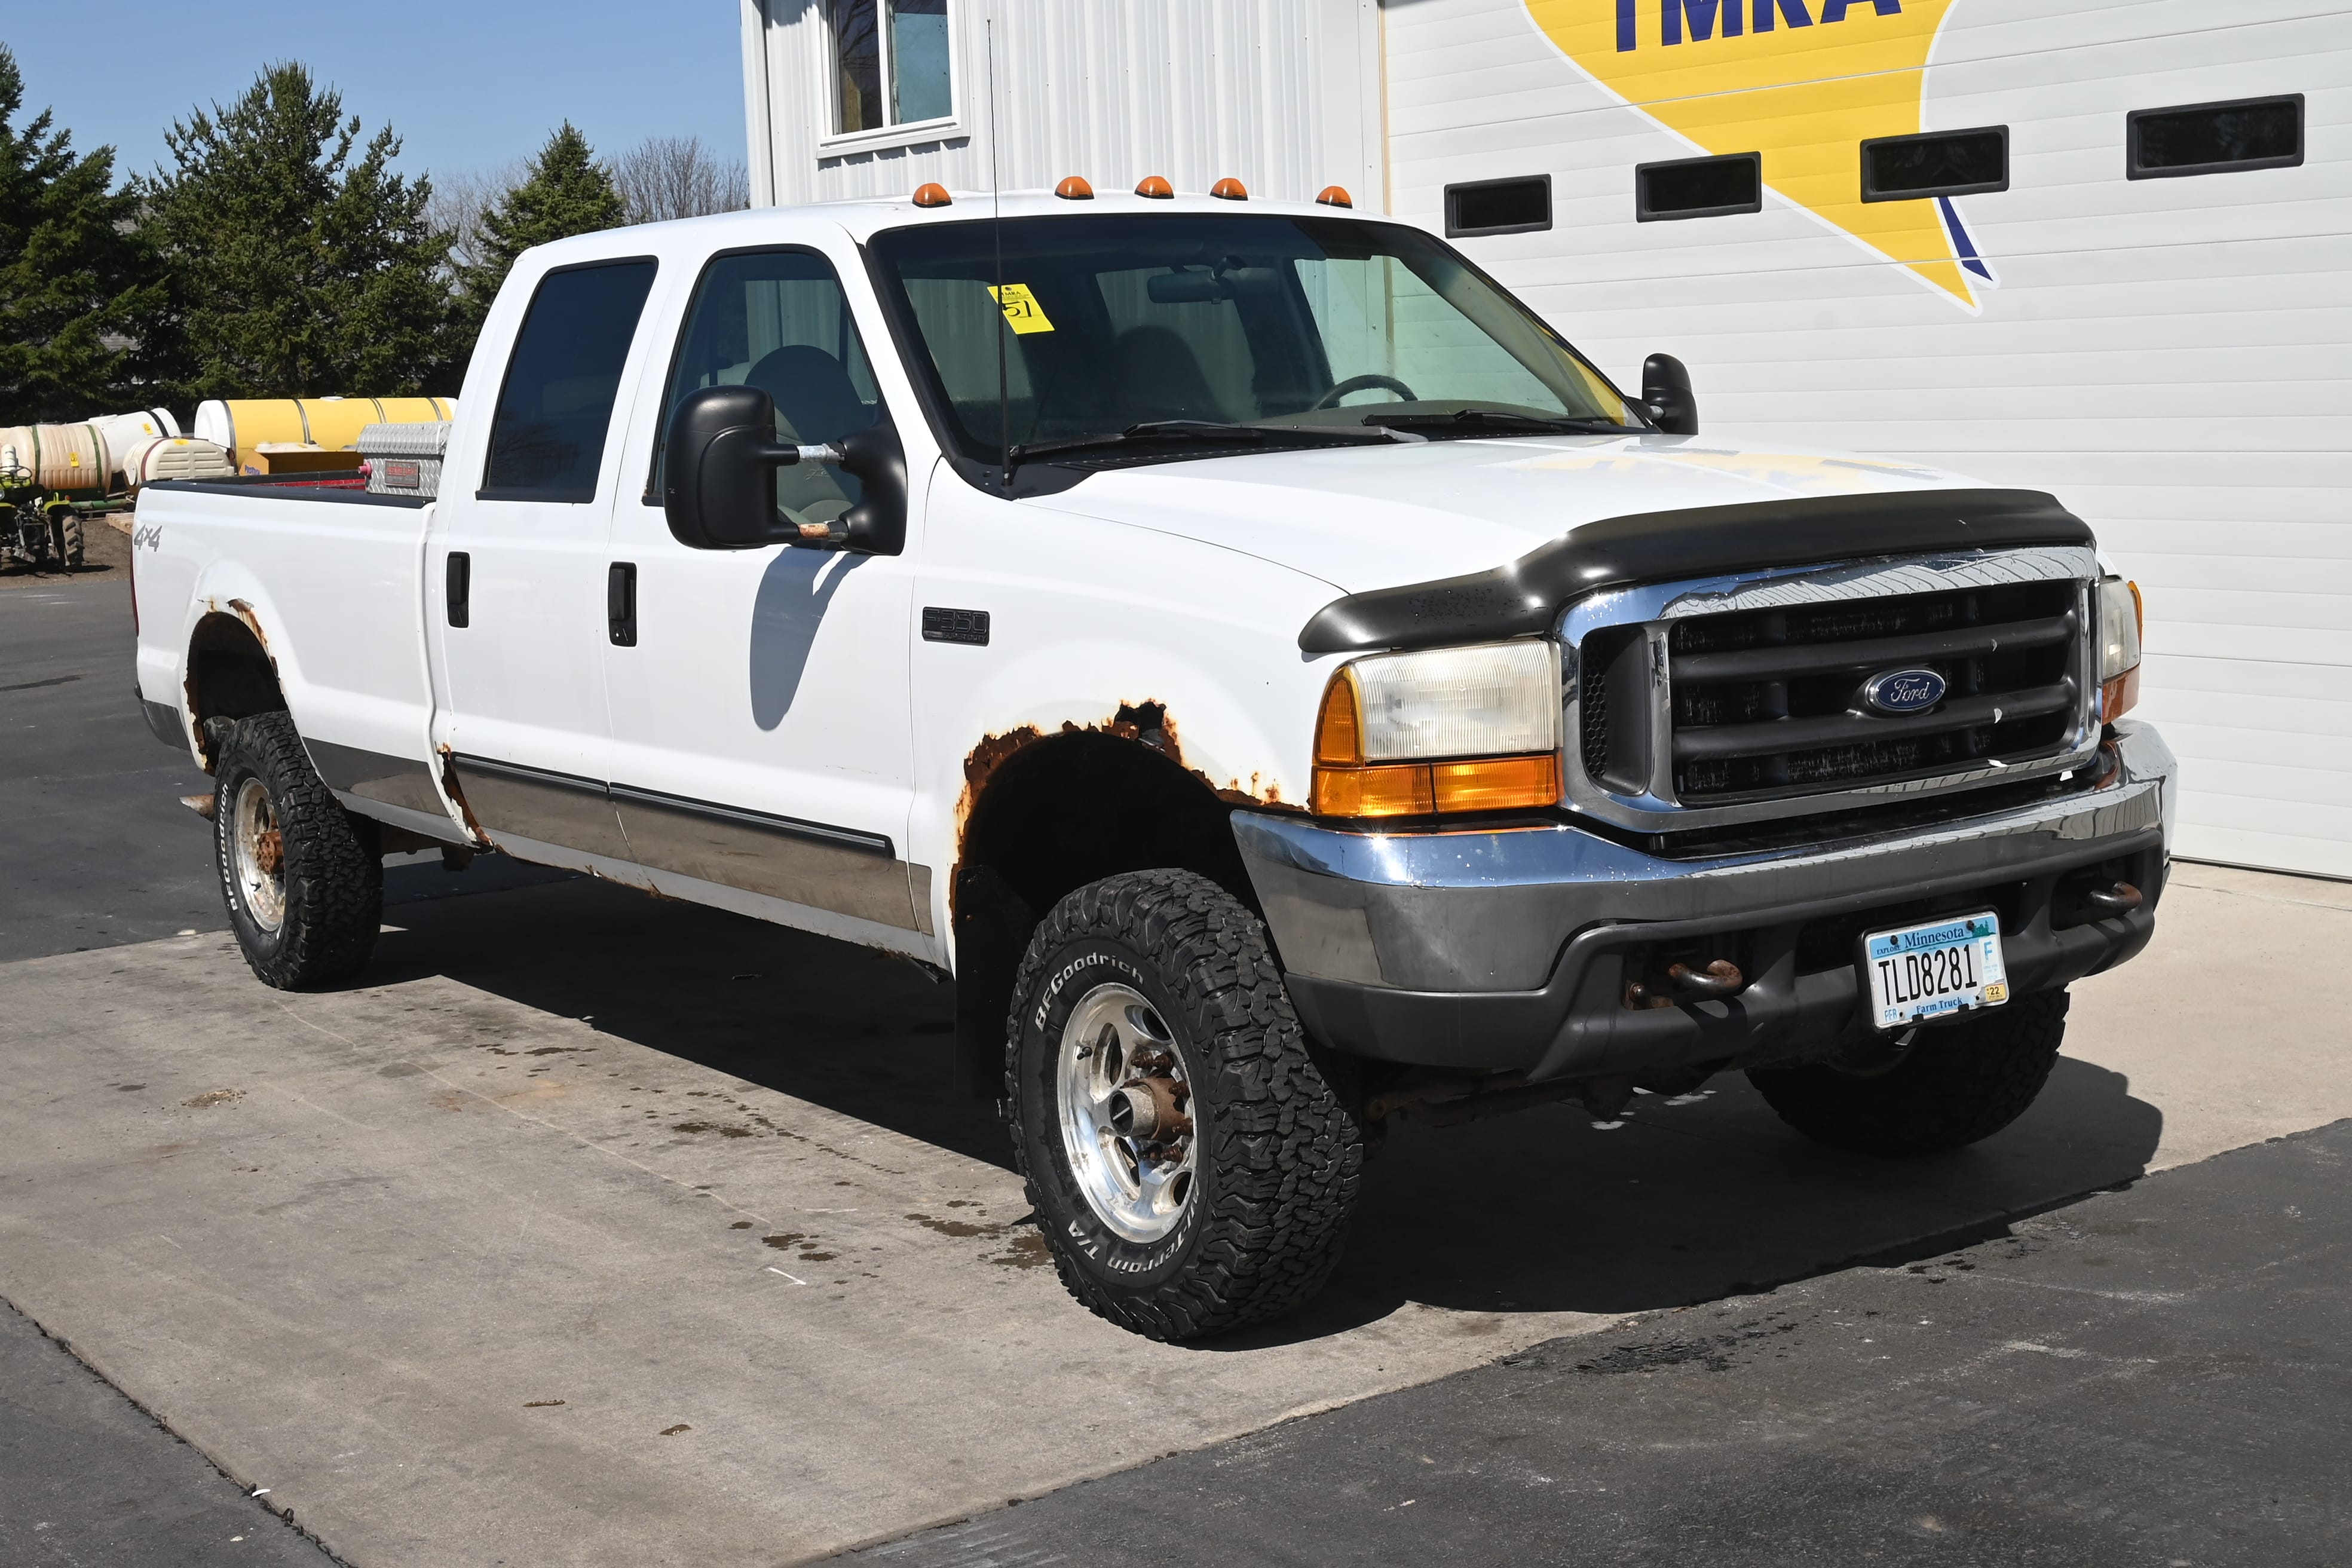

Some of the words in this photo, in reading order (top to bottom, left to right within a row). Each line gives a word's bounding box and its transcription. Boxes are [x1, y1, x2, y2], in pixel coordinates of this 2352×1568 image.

[1891, 678, 1930, 703] Ford
[1876, 945, 1901, 955] EXPLORE
[1904, 927, 1964, 948] Minnesota
[1878, 944, 1977, 1006] TLD8281
[1035, 952, 1144, 1033] BFGoodrich
[1989, 986, 2000, 995] 22
[1916, 1003, 1937, 1015] Farm
[1938, 996, 1964, 1010] Truck
[1068, 1219, 1100, 1260] T/A
